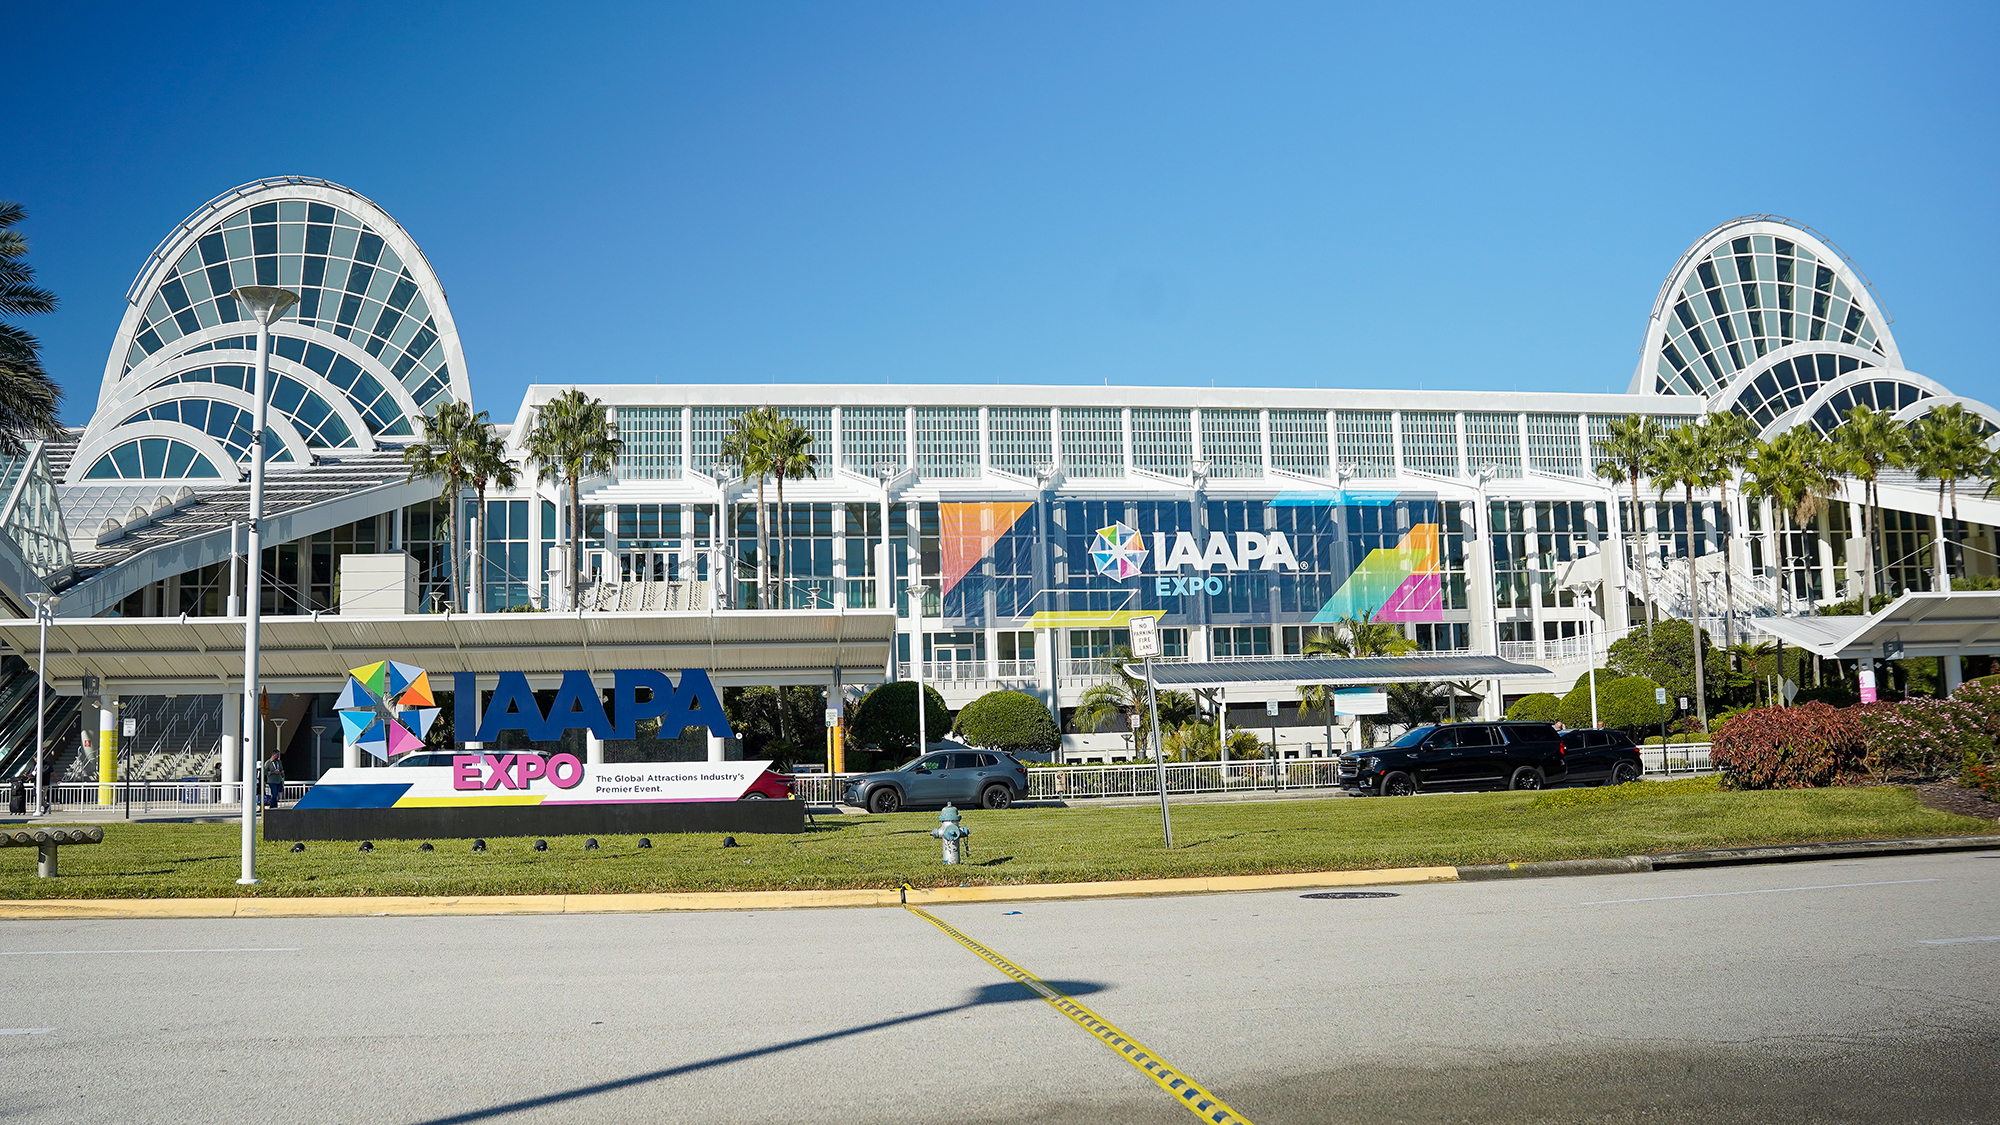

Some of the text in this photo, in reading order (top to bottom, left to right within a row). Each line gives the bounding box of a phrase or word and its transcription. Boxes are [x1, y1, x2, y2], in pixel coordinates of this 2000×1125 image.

[1152, 531, 1300, 571] IAAPA
[1155, 576, 1223, 597] EXPO
[1133, 629, 1155, 637] PARKING
[451, 668, 735, 743] IAAPA
[453, 752, 585, 791] EXPO
[596, 772, 745, 783] The Global Attractions Industry's
[596, 785, 663, 793] Premier Event.
